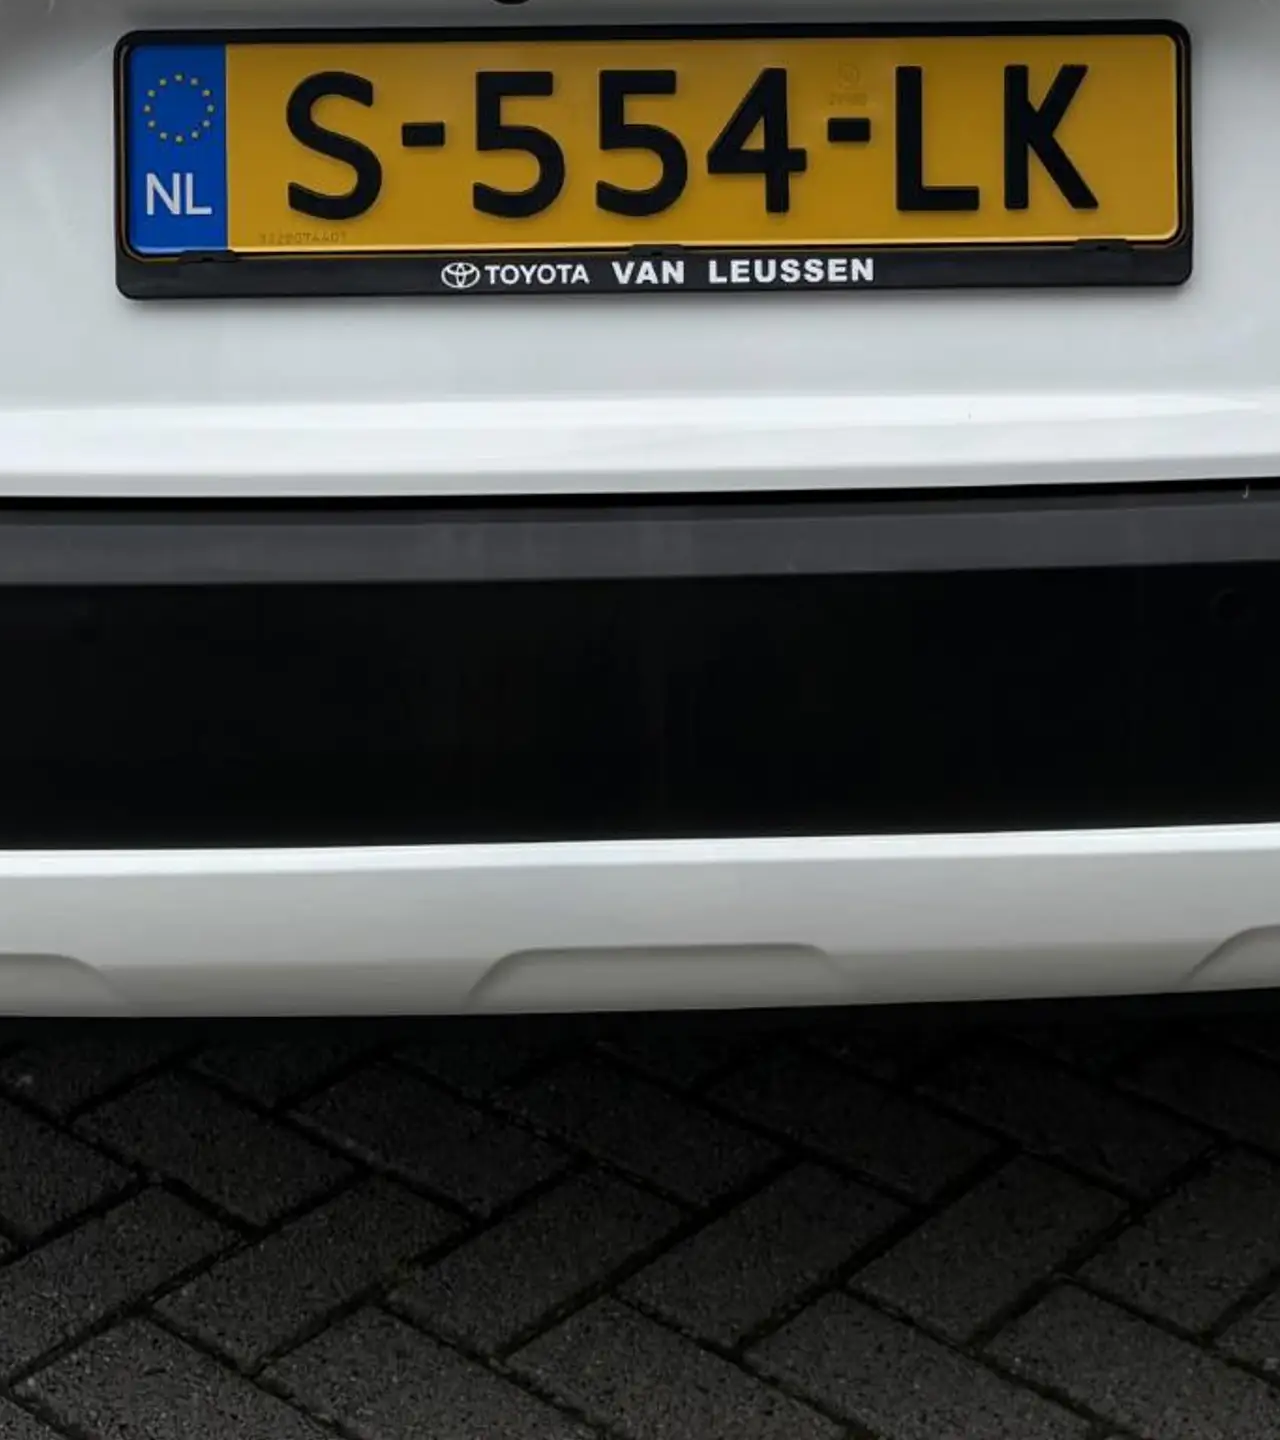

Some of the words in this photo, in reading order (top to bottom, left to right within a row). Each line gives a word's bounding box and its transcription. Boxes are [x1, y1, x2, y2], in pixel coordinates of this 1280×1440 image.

[286, 65, 1099, 220] S-554-LK
[146, 173, 213, 215] NL
[485, 264, 590, 286] TOYOTA
[612, 261, 685, 284] VAN
[708, 258, 875, 283] LEUSSEN
